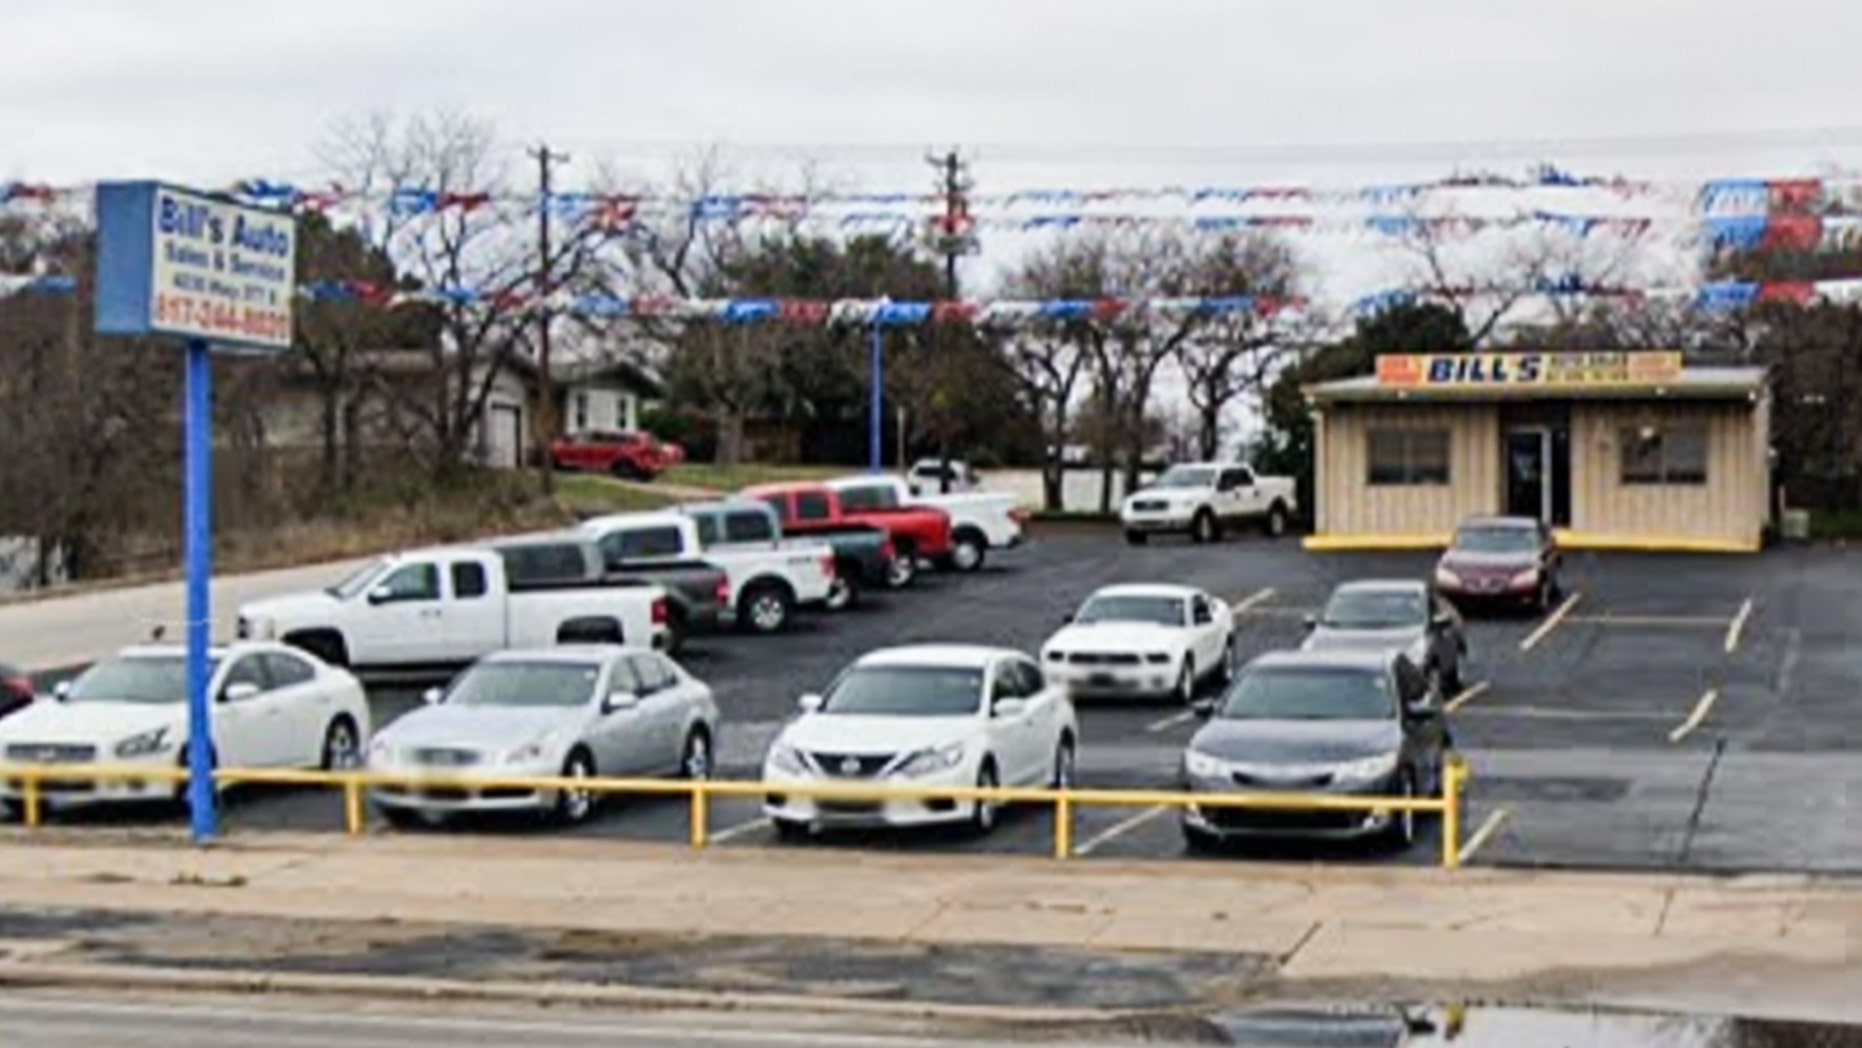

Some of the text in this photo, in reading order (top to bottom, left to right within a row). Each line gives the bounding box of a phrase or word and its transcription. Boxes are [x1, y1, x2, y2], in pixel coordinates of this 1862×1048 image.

[158, 195, 289, 259] Bill's Auto
[213, 250, 225, 271] &
[1427, 355, 1542, 382] BILL'S
